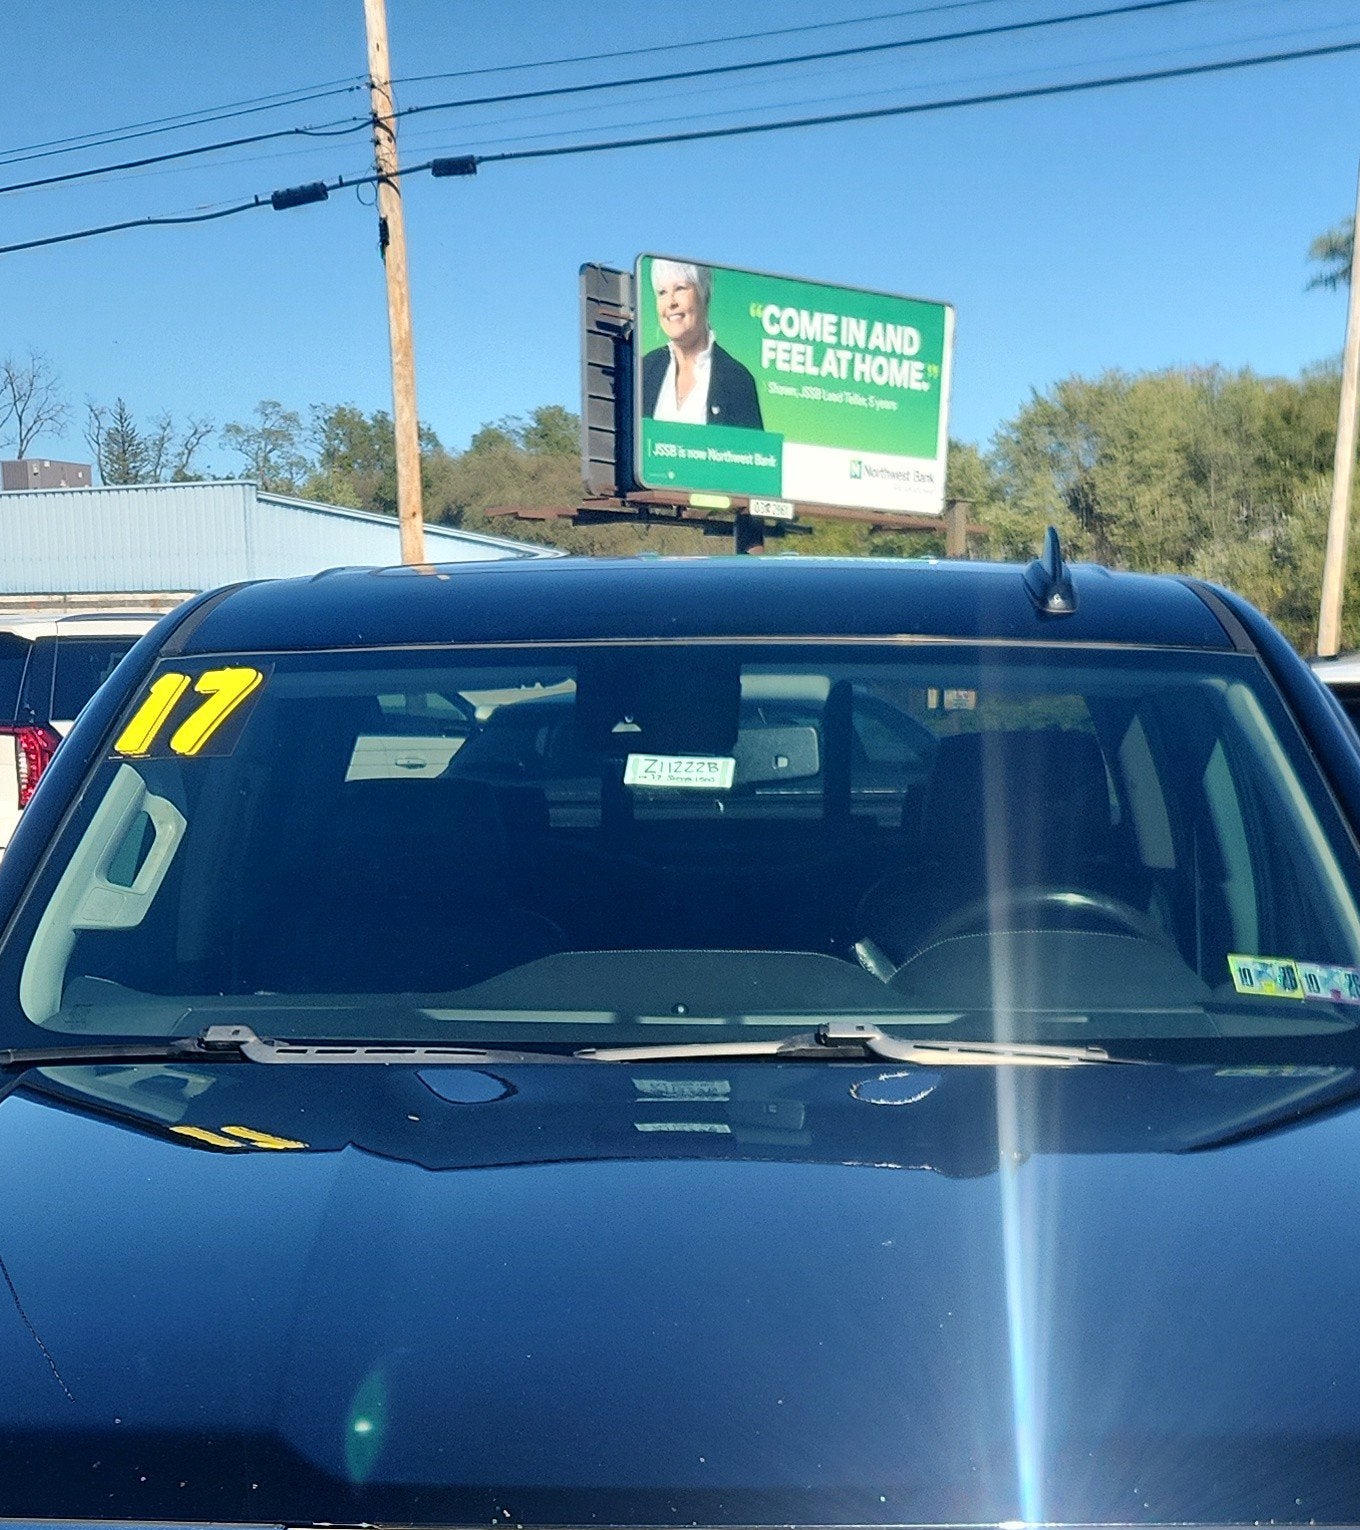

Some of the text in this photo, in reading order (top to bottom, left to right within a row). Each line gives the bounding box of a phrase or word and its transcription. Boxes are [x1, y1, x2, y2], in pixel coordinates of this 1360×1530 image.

[841, 315, 868, 349] IN
[869, 321, 921, 356] AND
[761, 338, 819, 376] FEEL
[820, 347, 853, 380] AT
[707, 447, 753, 466] Northwest
[754, 453, 777, 468] Bank
[864, 464, 935, 484] Northwest Bank
[114, 667, 263, 756] 17
